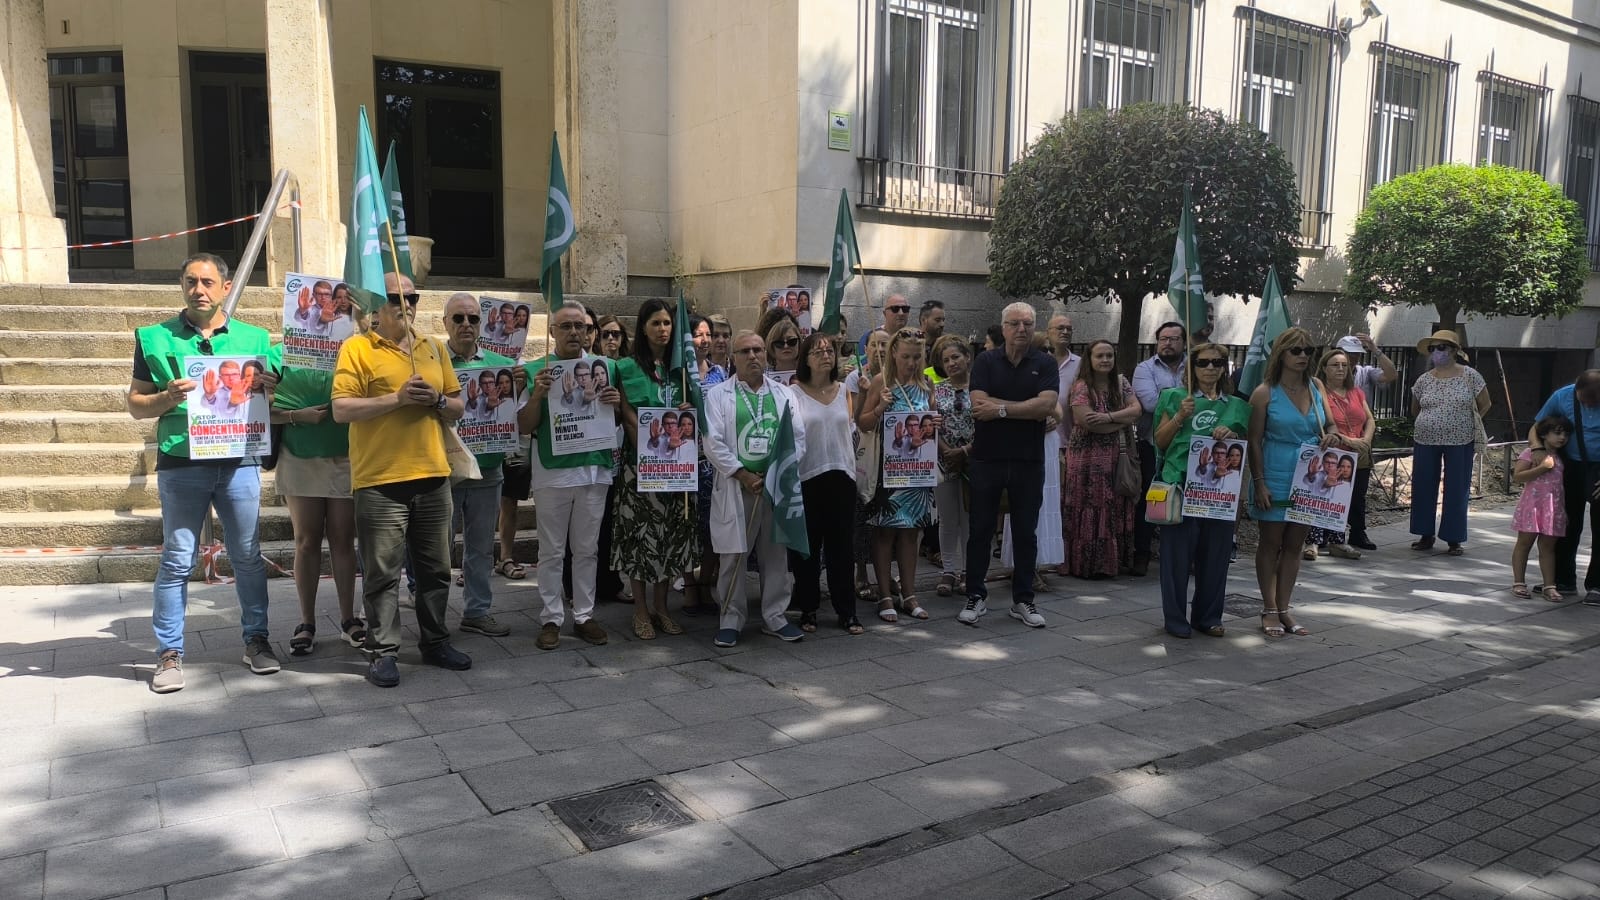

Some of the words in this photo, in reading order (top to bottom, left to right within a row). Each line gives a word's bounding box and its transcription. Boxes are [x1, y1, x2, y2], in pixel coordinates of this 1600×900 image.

[190, 420, 265, 436] CONCENTRACIÓN
[457, 421, 515, 437] CONCENTRACIÓN
[555, 424, 578, 434] MINUTO
[563, 432, 584, 441] SILENCIO
[639, 461, 695, 472] CONCENTRACIÓN
[884, 460, 934, 470] CONCENTRACIÓN
[1184, 489, 1236, 502] CONCENTRACIÓN
[1290, 495, 1346, 513] CONCENTRACIÓN
